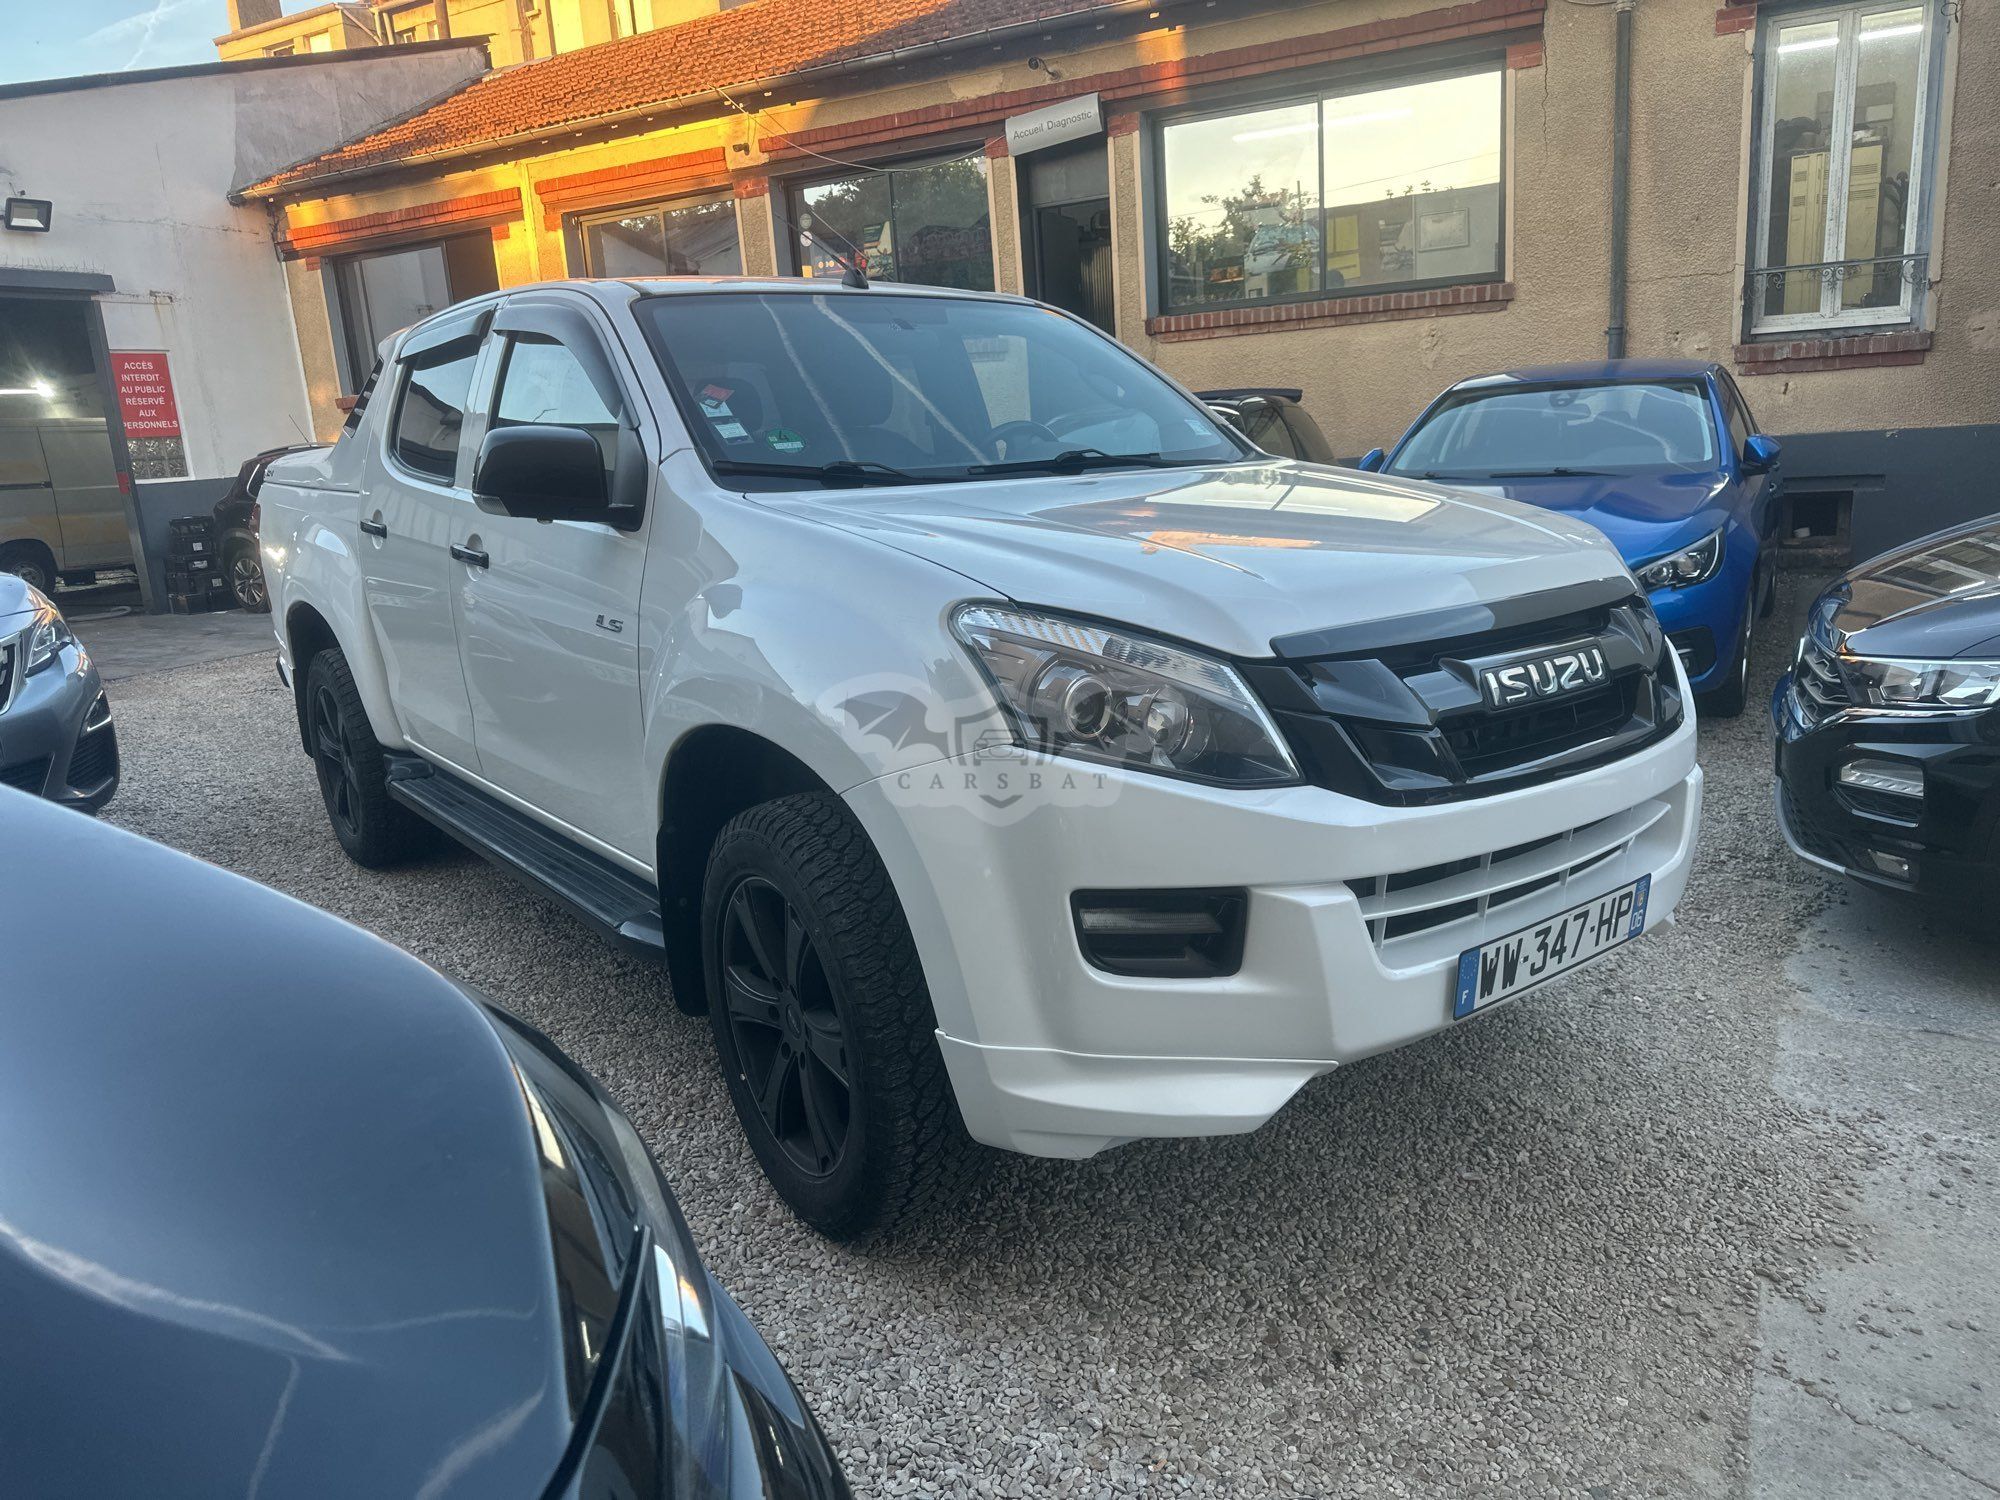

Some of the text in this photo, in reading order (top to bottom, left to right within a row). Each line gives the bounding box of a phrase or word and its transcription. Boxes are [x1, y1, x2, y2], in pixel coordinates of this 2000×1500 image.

[1013, 110, 1092, 140] Accueil Diagnostic
[122, 374, 159, 382] INTERDIT
[121, 385, 165, 394] AU PUBLIC
[139, 409, 157, 417] AUX
[596, 614, 624, 633] LS
[1485, 648, 1604, 707] ISUZU
[1461, 890, 1644, 1005] F WW-347-HP 06
